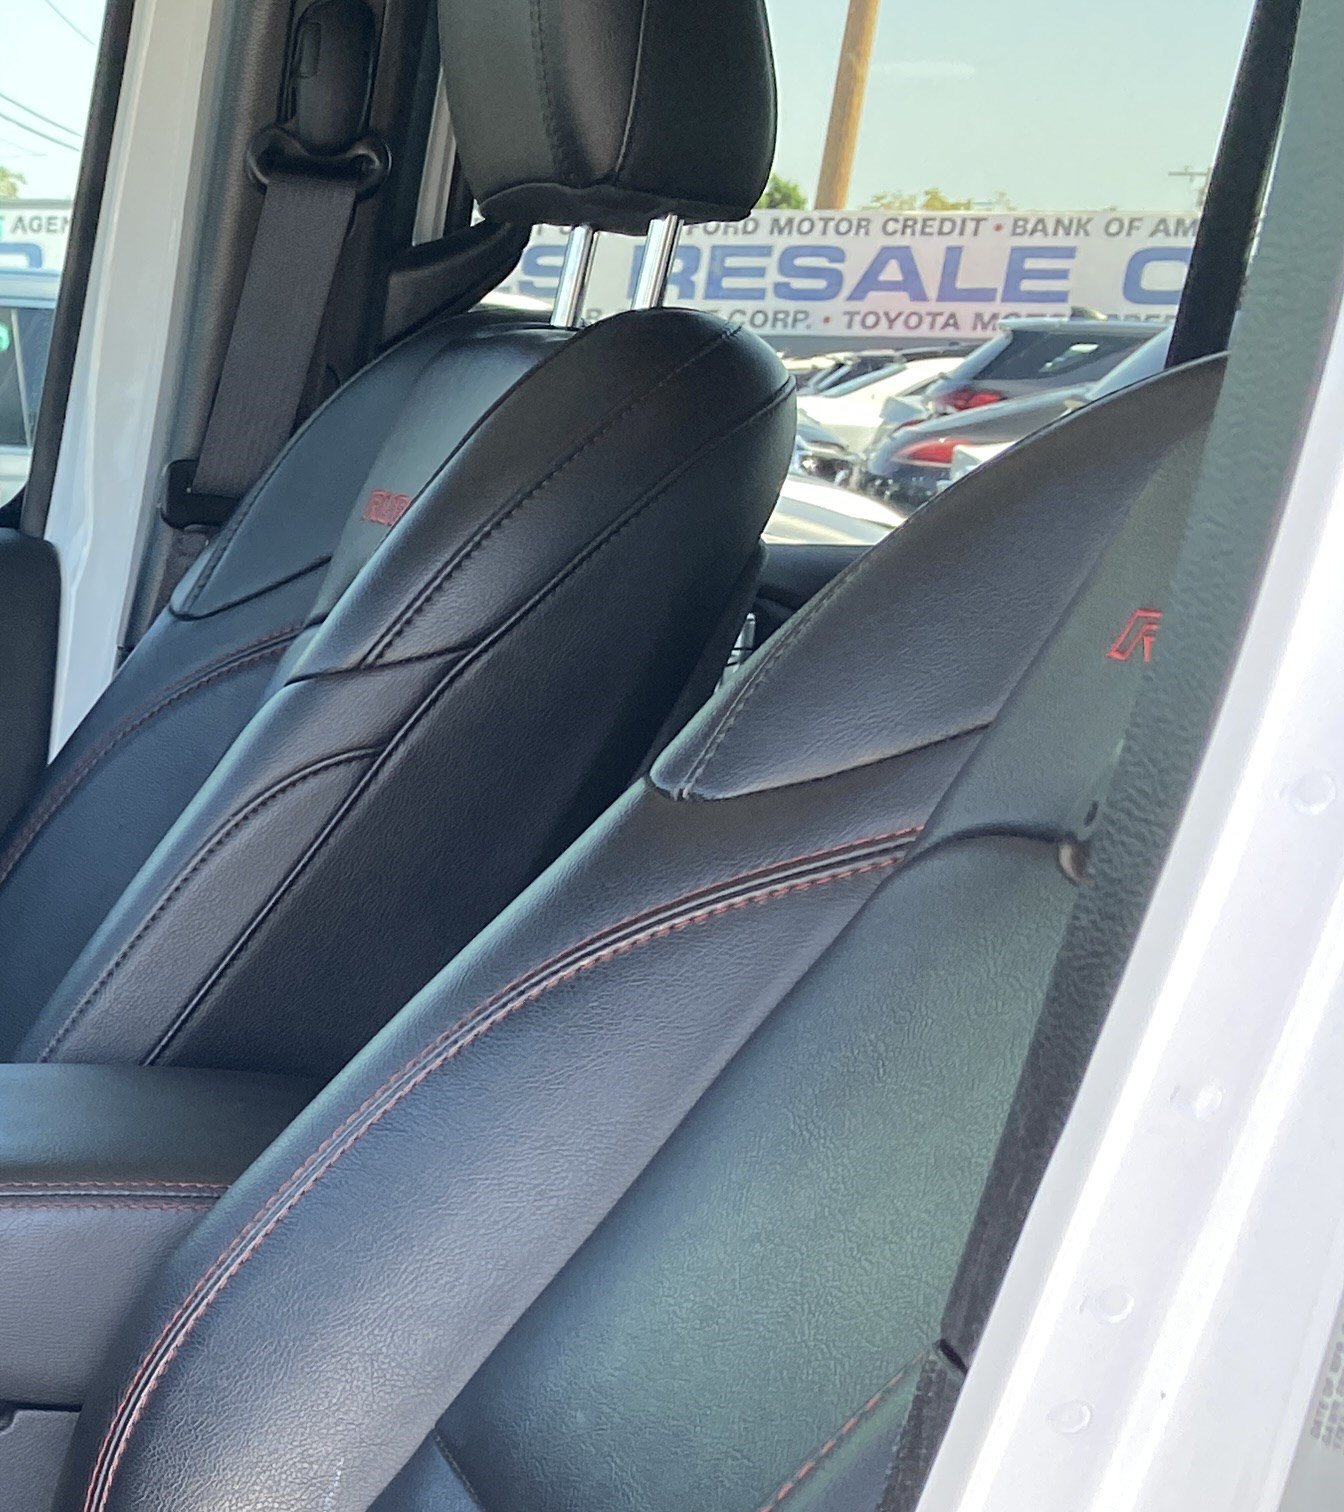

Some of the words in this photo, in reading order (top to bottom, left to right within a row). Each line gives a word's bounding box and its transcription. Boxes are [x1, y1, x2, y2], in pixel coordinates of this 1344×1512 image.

[769, 217, 877, 236] MOTOR
[881, 216, 987, 237] CREDIT
[1009, 217, 1094, 237] BANK
[1104, 217, 1143, 237] OF
[627, 244, 1078, 304] RESALE
[843, 310, 960, 331] TOYOTA
